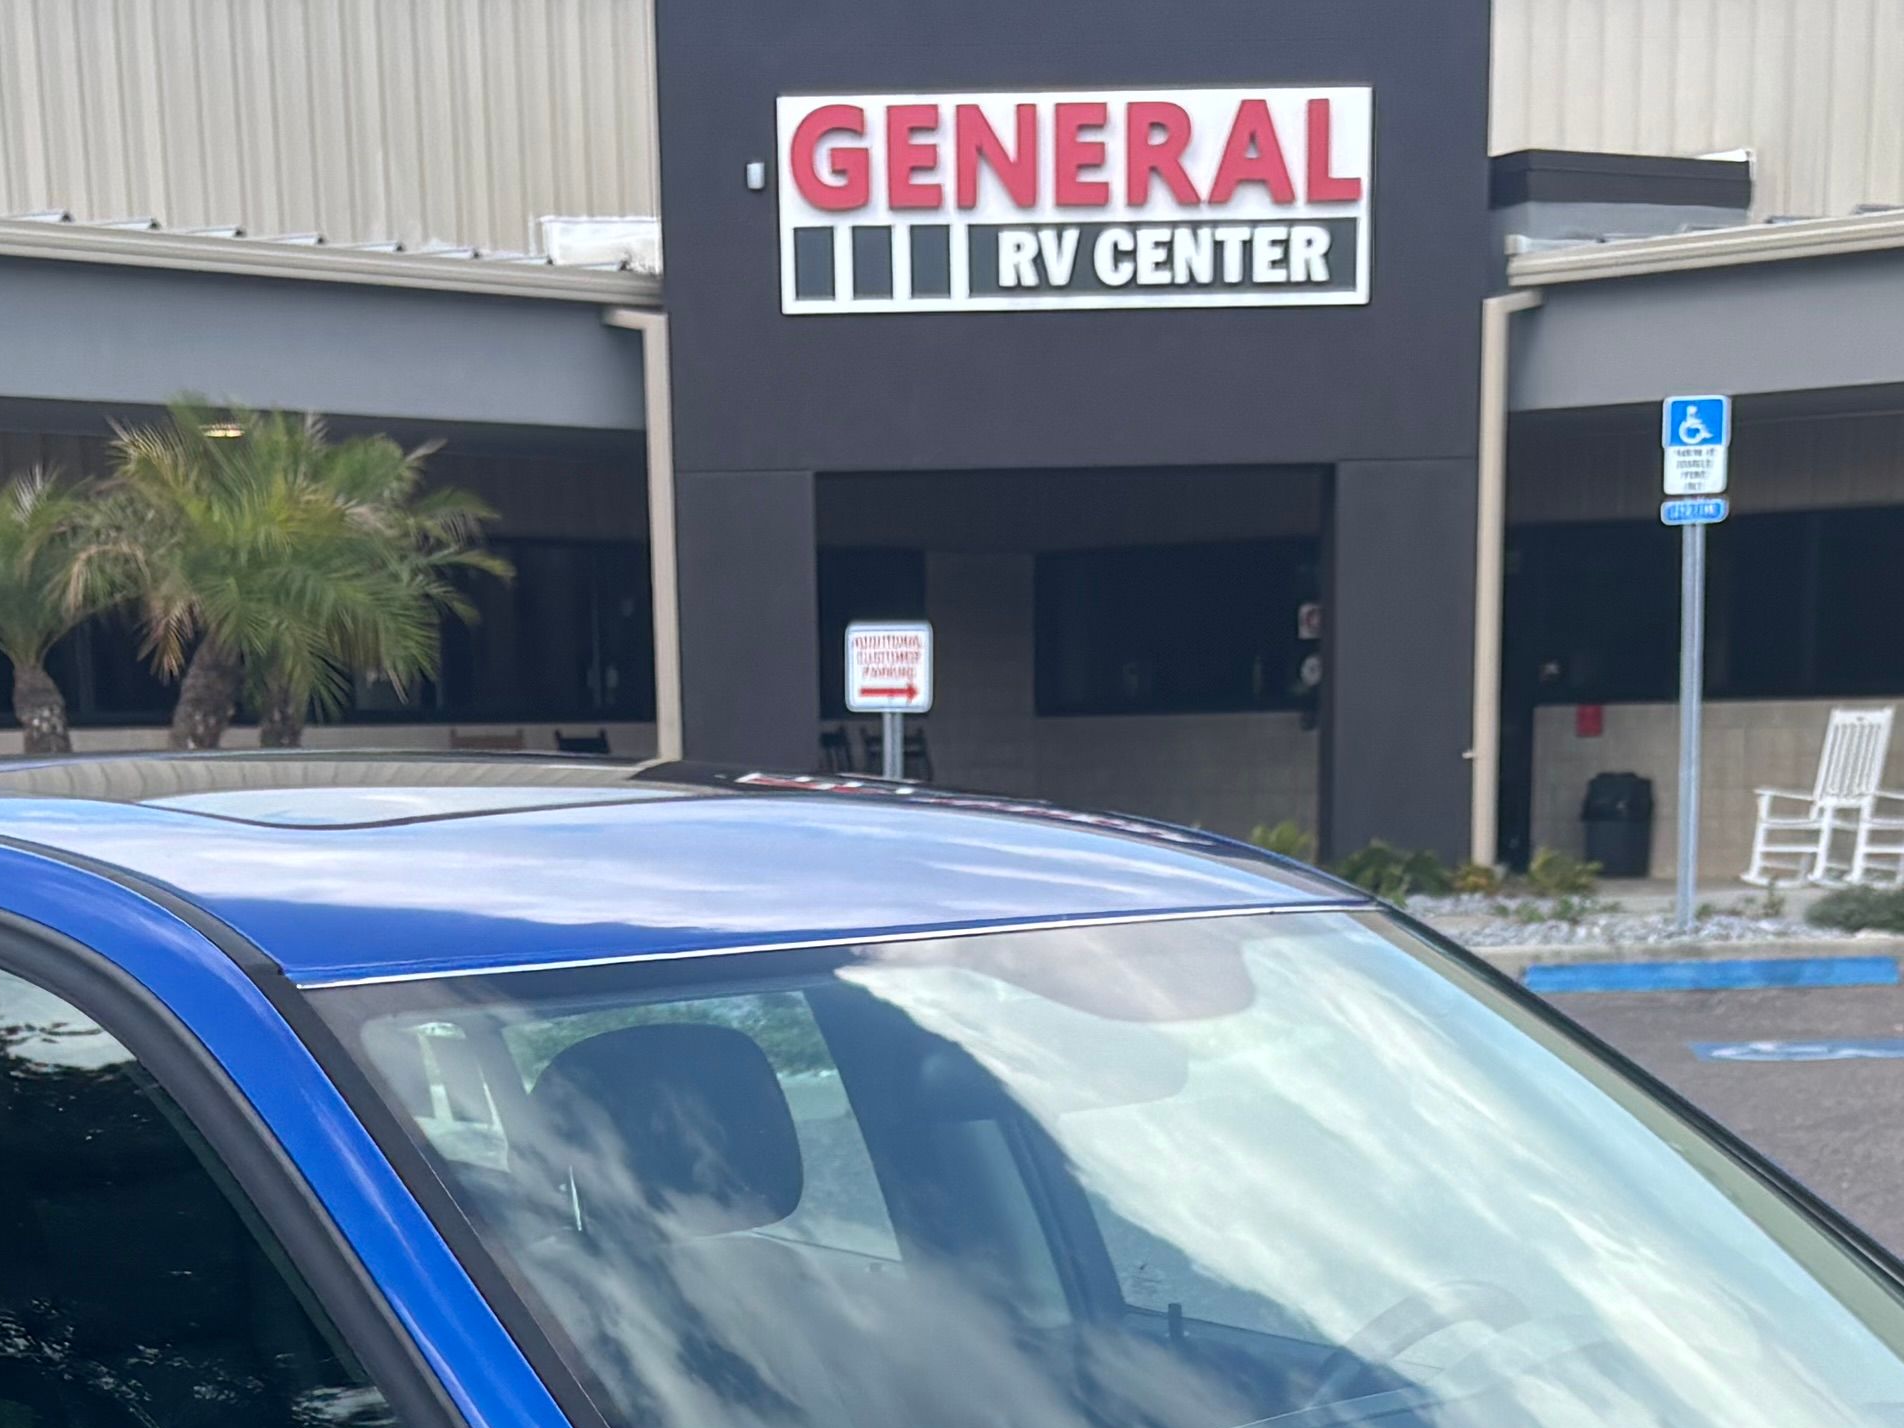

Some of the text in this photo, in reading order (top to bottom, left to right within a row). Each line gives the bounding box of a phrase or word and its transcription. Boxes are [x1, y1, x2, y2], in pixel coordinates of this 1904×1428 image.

[789, 98, 1362, 211] GENERAL
[997, 225, 1332, 287] RV CENTER
